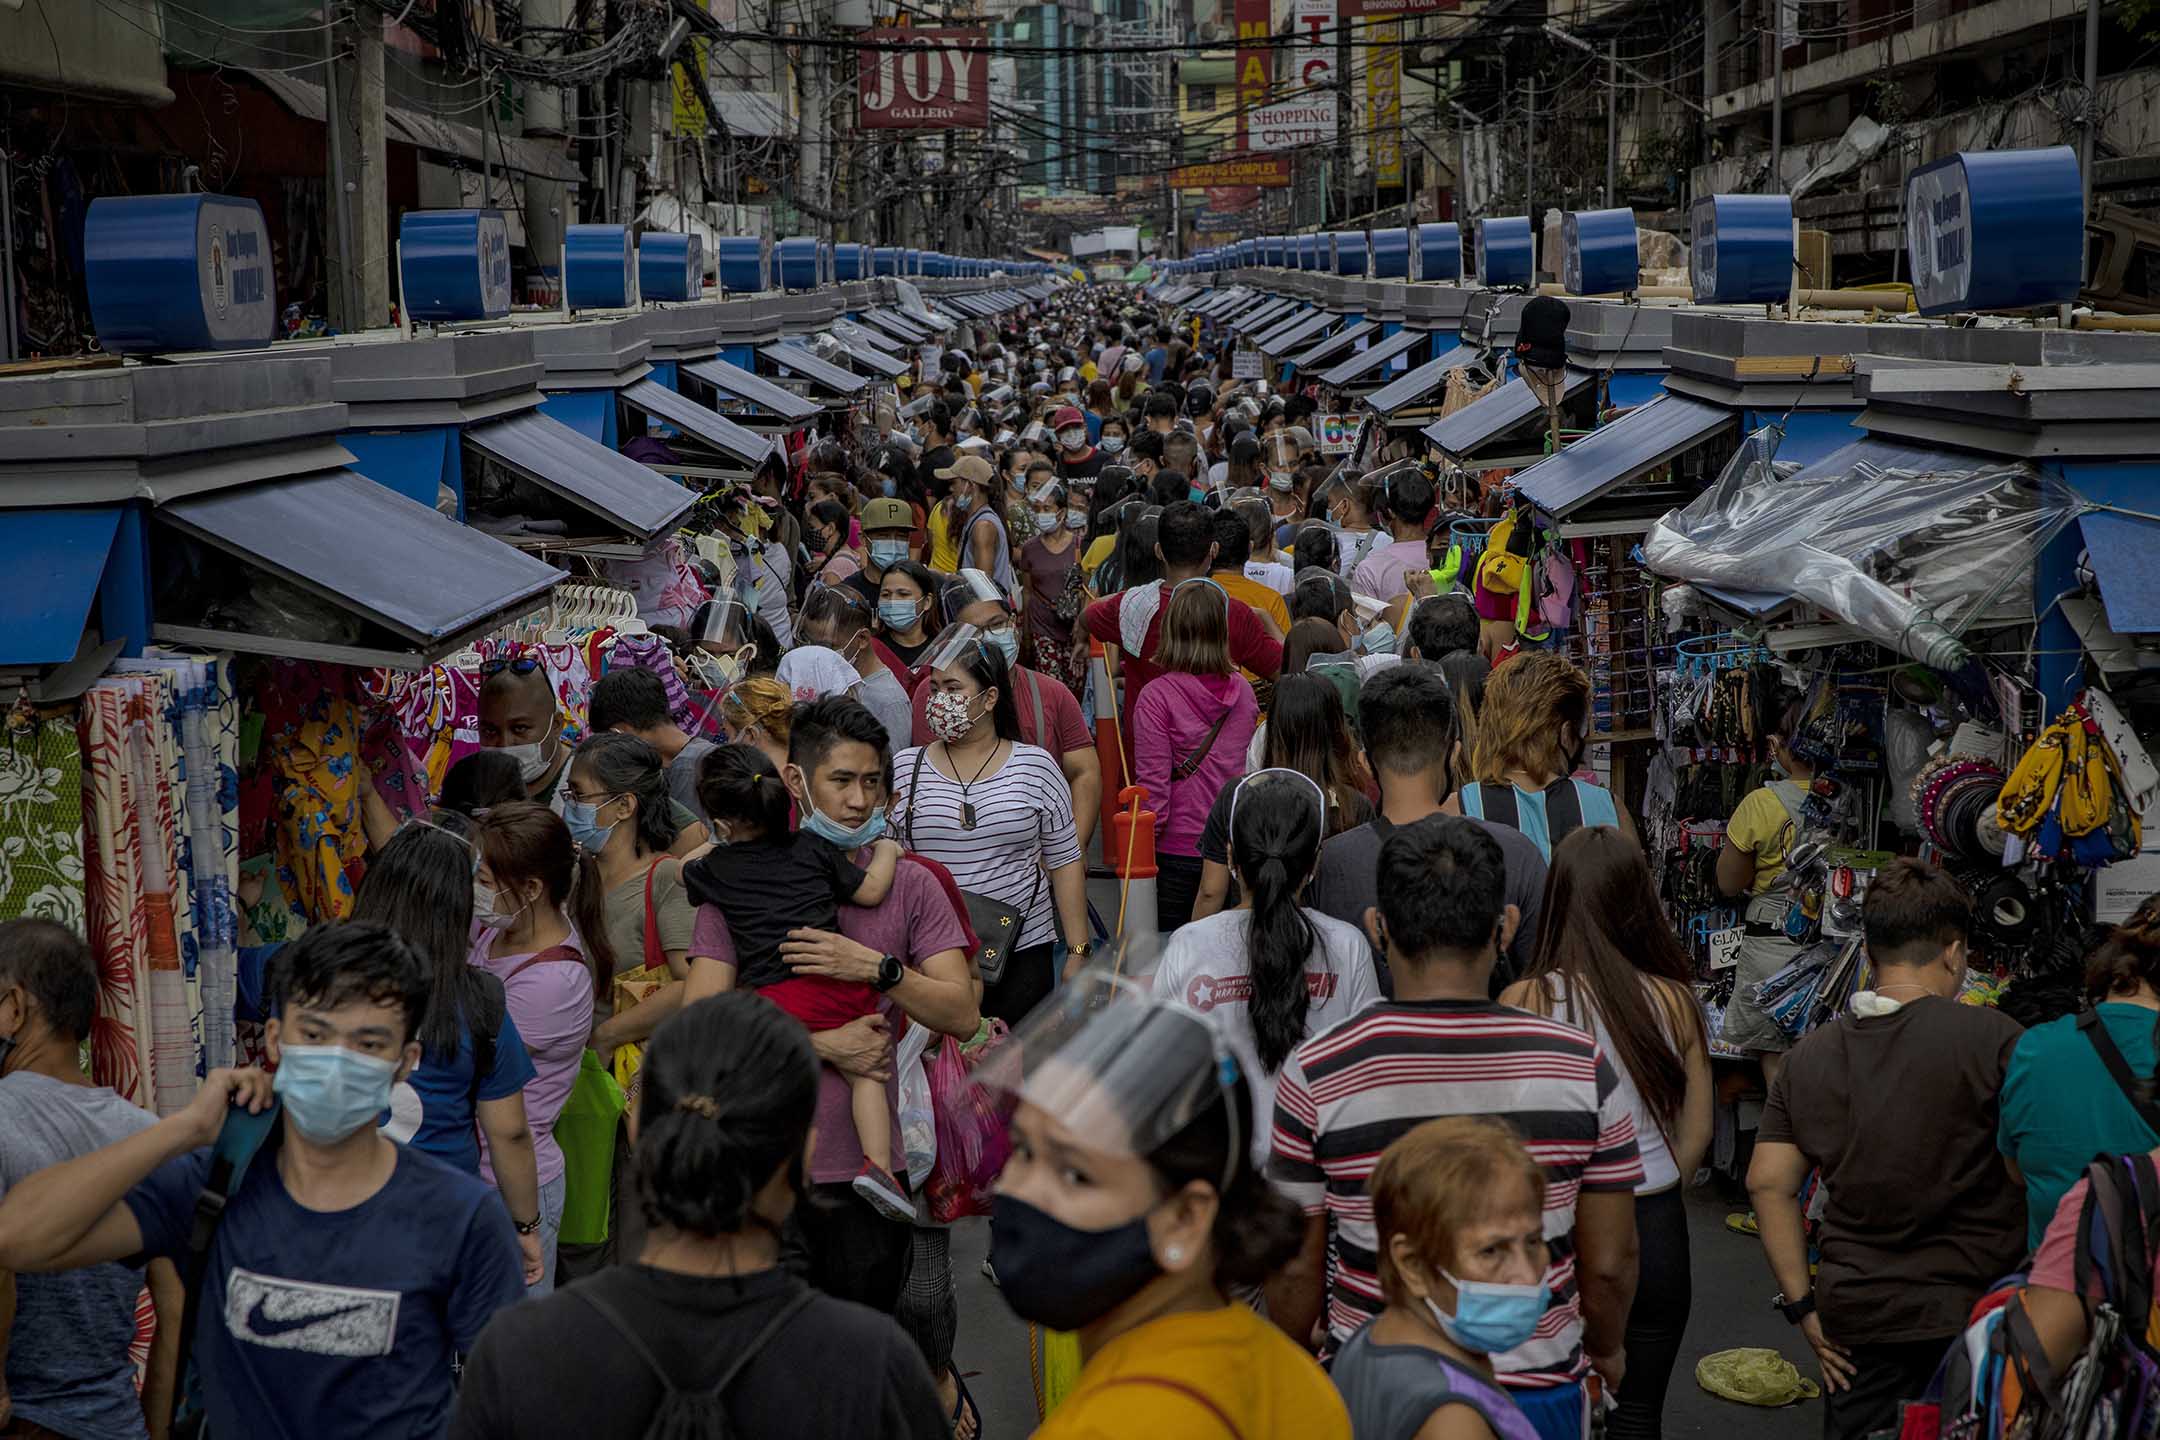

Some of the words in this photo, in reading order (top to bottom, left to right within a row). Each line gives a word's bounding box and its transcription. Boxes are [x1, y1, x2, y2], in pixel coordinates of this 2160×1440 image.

[1362, 0, 1406, 10] BINONDO
[863, 35, 983, 111] JOY
[890, 106, 957, 119] GALLERY
[1254, 109, 1330, 125] SHOPPING
[1262, 128, 1322, 145] CENTER
[1229, 160, 1278, 176] COMPLEX
[888, 504, 898, 519] P
